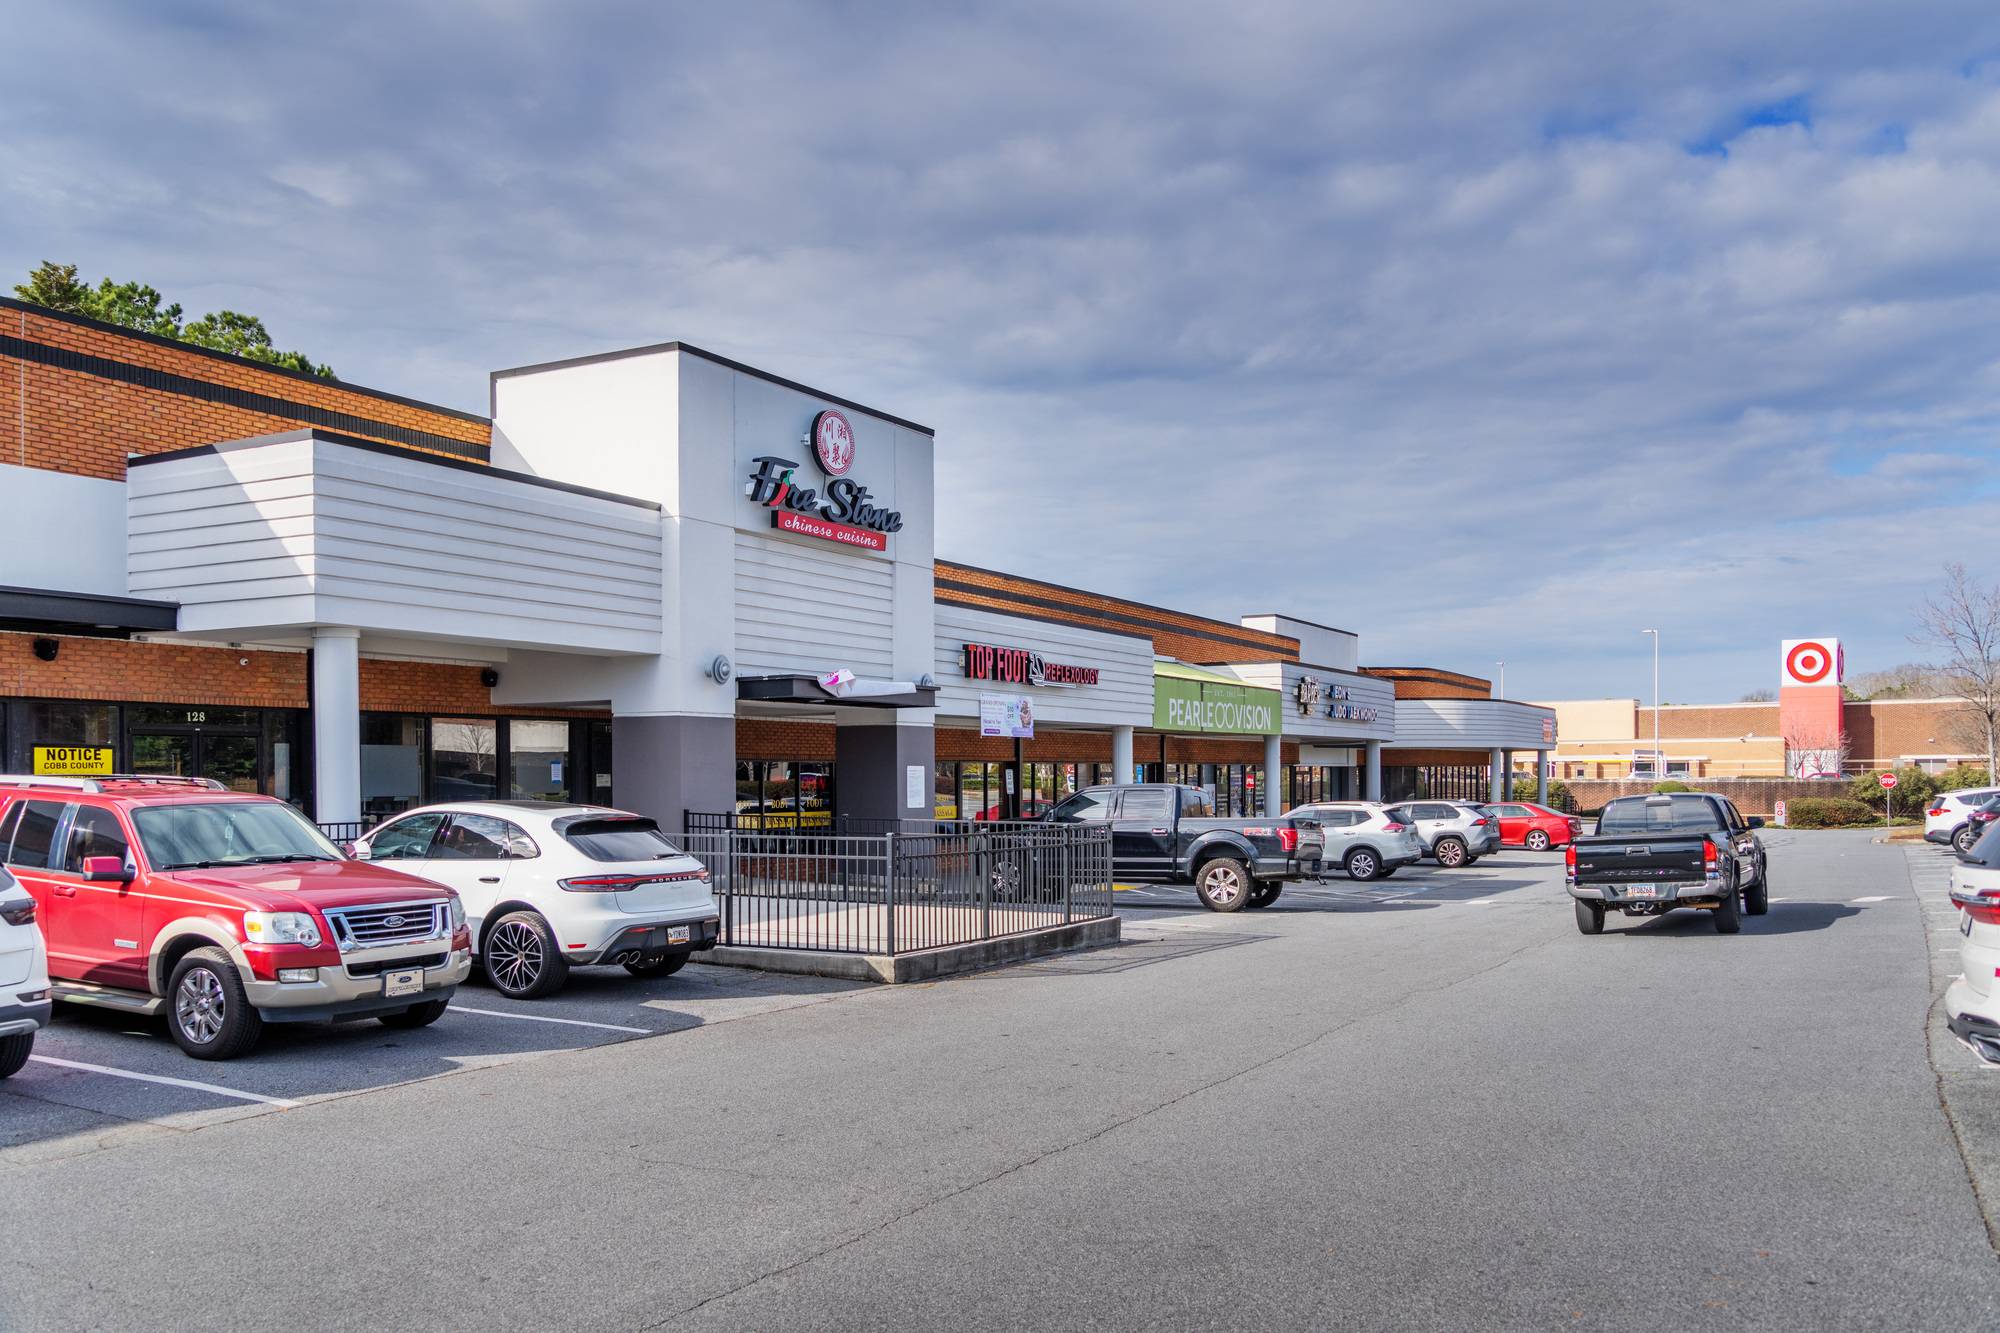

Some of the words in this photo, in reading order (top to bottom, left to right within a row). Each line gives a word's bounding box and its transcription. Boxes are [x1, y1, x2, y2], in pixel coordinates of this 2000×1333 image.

[750, 456, 818, 511] Fire
[821, 478, 903, 532] Stone
[784, 513, 833, 537] chinese
[836, 532, 879, 547] cuisine
[966, 643, 994, 681] TOP
[996, 647, 1030, 684] FOOT
[1045, 662, 1100, 685] REFLEXOLOGY
[186, 711, 206, 722] 128
[1168, 698, 1214, 728] PEARLE
[1235, 704, 1271, 731] VISION
[46, 748, 102, 761] NOTICE
[43, 762, 68, 770] COBB
[70, 761, 105, 770] COUNTY
[1881, 777, 1897, 785] STOP
[771, 799, 788, 809] BODY
[806, 799, 823, 808] FOOT
[651, 875, 692, 883] PORSCHE
